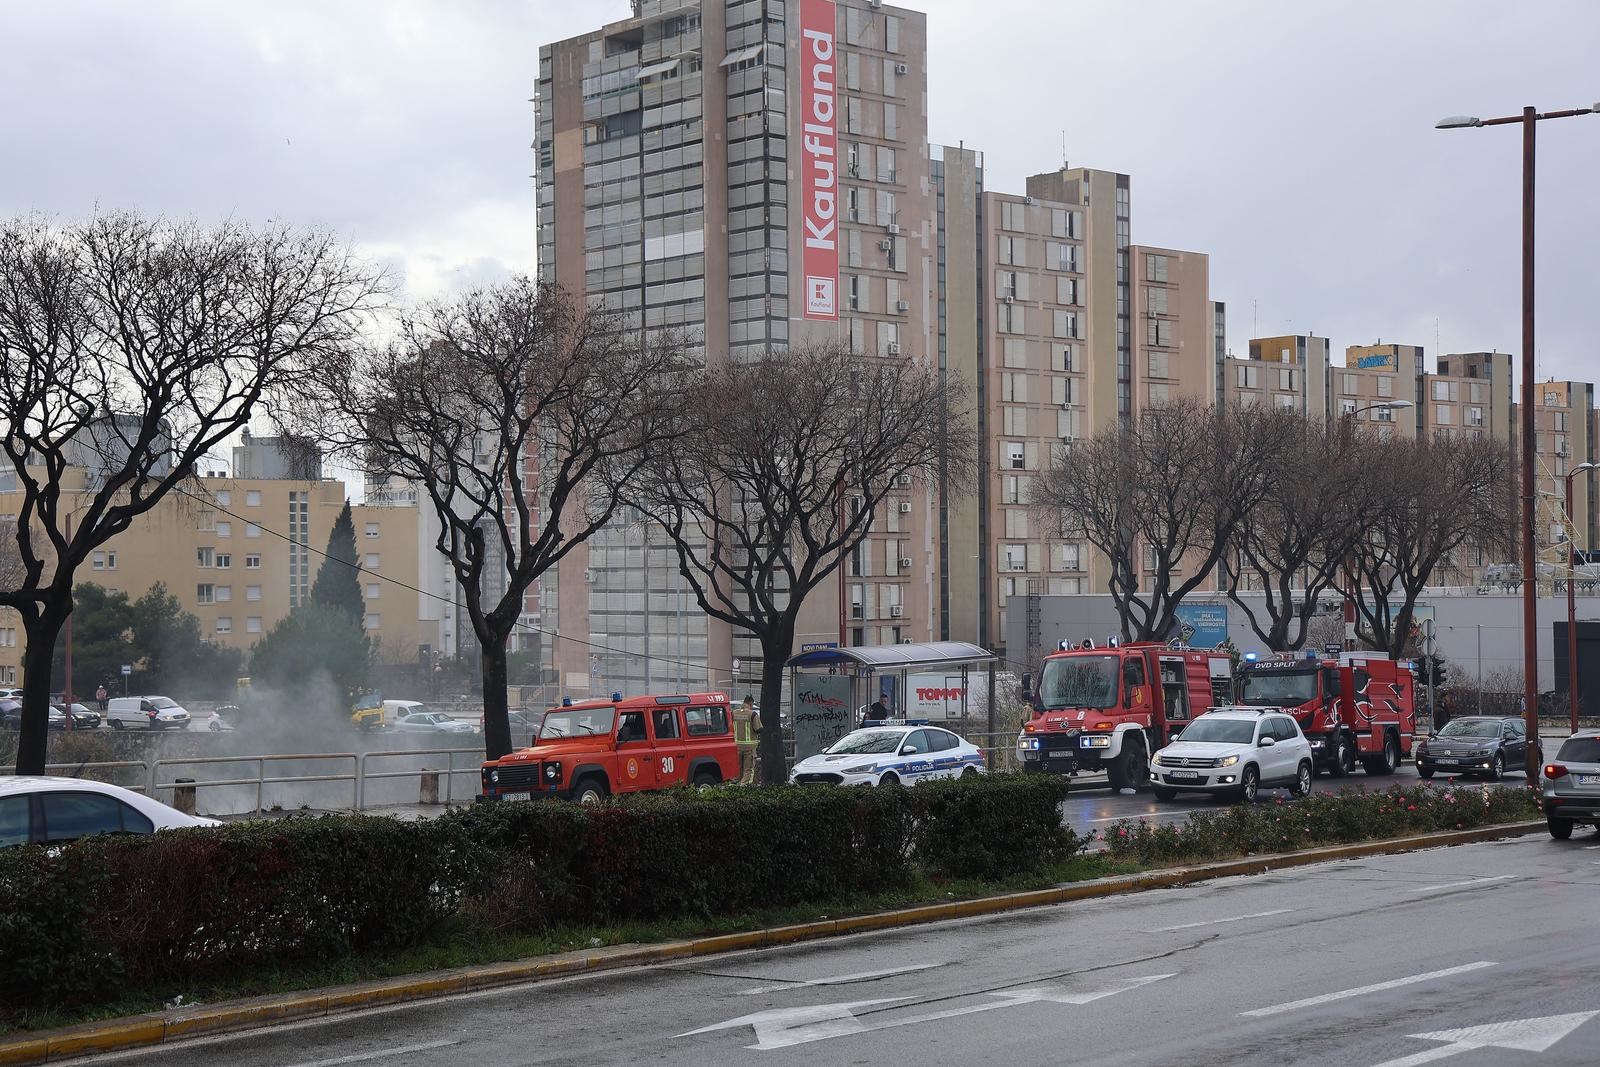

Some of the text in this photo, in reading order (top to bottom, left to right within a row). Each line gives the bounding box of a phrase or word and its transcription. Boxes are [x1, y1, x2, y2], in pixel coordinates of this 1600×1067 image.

[804, 29, 835, 250] Kaufland
[1255, 661, 1272, 669] DVD
[916, 688, 969, 701] TOMMY
[1077, 711, 1085, 721] 8
[662, 756, 674, 774] 30
[911, 763, 934, 772] POLICIJA
